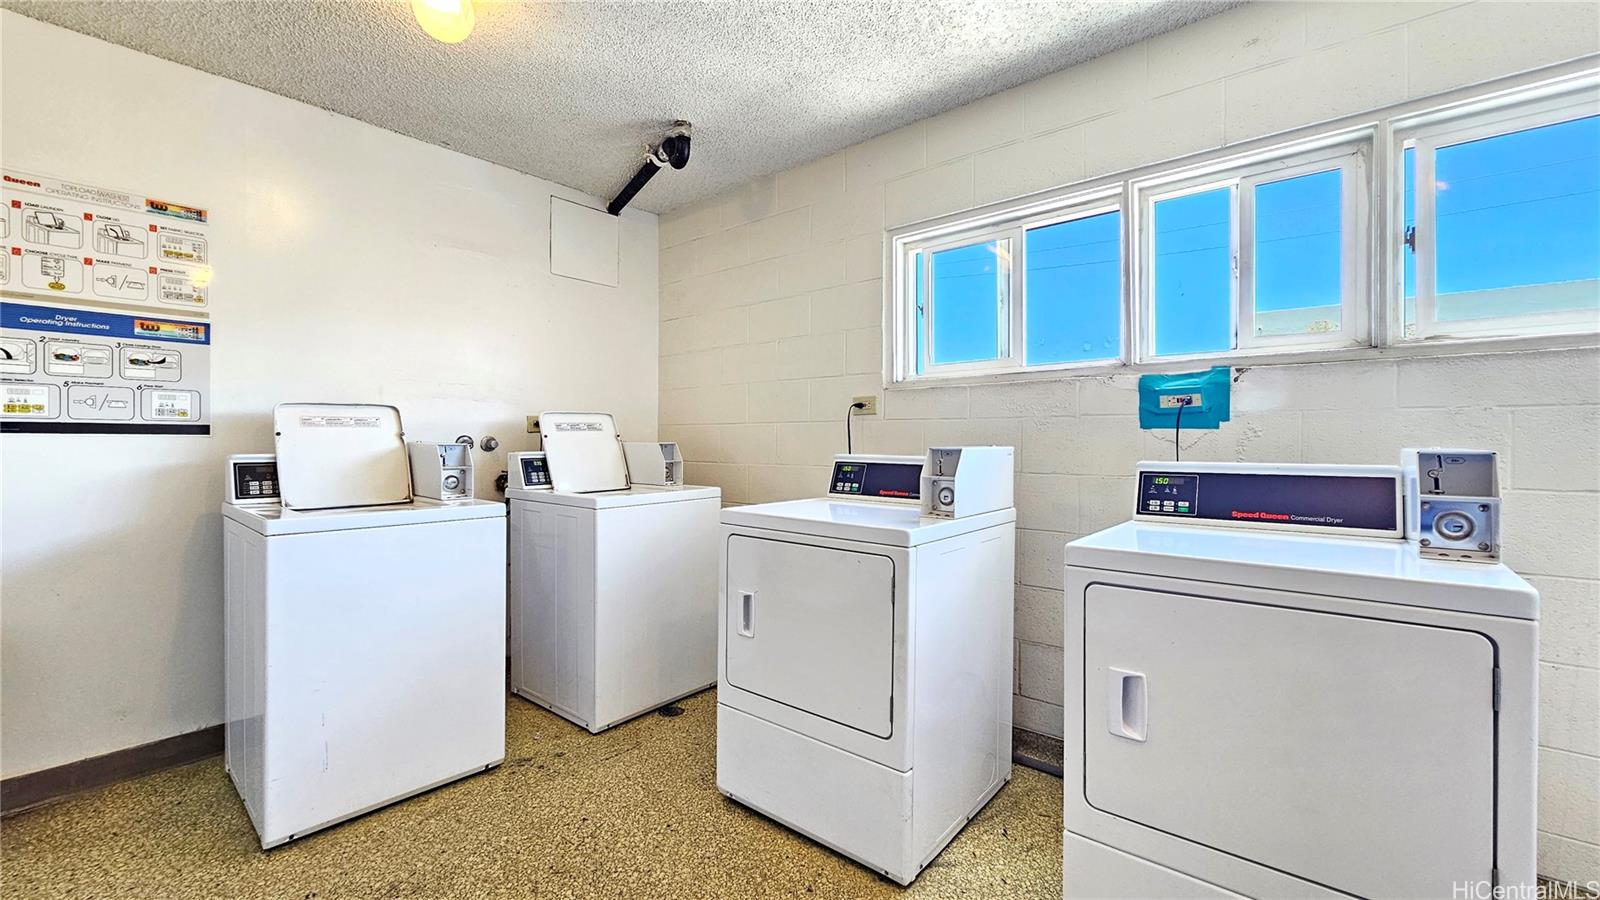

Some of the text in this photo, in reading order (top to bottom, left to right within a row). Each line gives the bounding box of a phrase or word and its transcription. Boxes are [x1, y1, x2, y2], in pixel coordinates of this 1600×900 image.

[3, 175, 41, 188] Queen
[46, 188, 141, 209] OPERATING INSTRUCTIONS
[19, 316, 110, 330] Operating Instructions
[55, 314, 78, 322] Dryer
[39, 335, 46, 343] 2
[1231, 510, 1259, 519] Speed
[1260, 512, 1289, 521] Queen
[1326, 516, 1344, 524] Dryer
